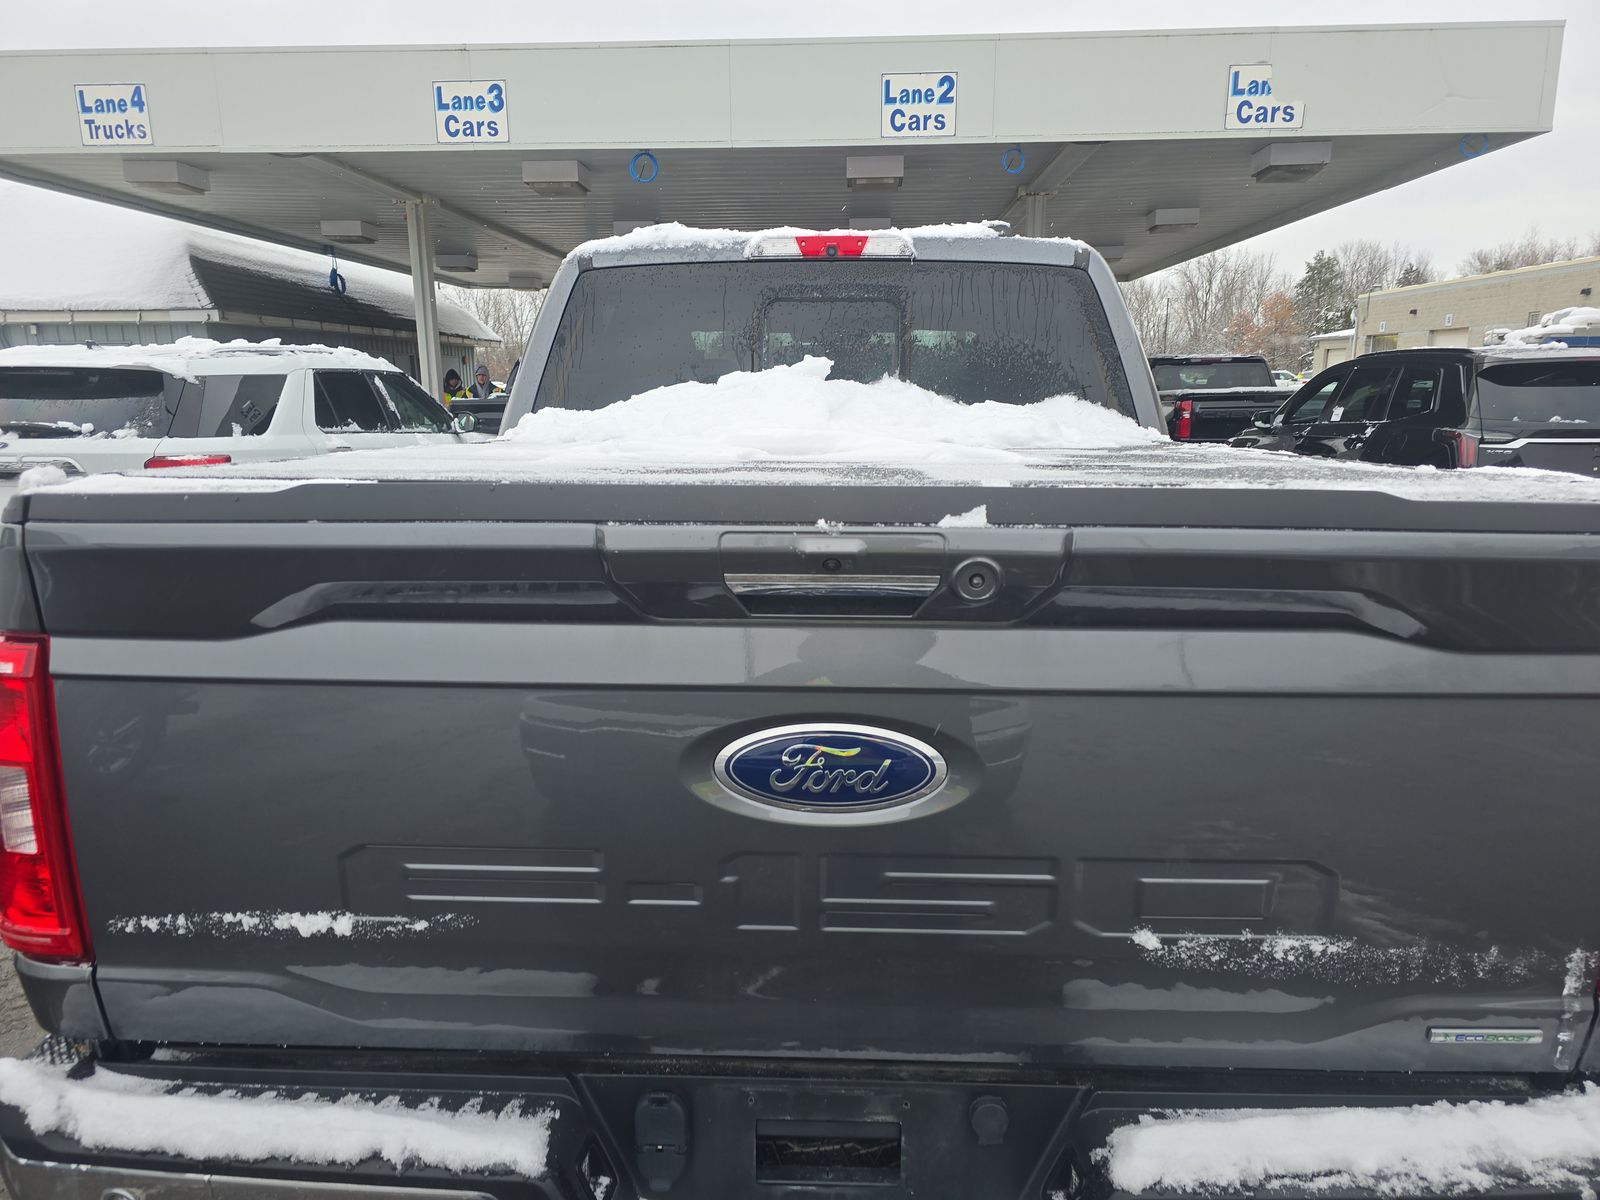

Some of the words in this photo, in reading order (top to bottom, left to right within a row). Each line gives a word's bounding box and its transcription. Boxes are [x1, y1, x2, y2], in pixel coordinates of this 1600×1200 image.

[890, 108, 946, 132] Cars
[1236, 99, 1295, 124] Cars
[84, 119, 147, 139] Trucks
[444, 114, 499, 138] Cars
[769, 743, 892, 793] Ford
